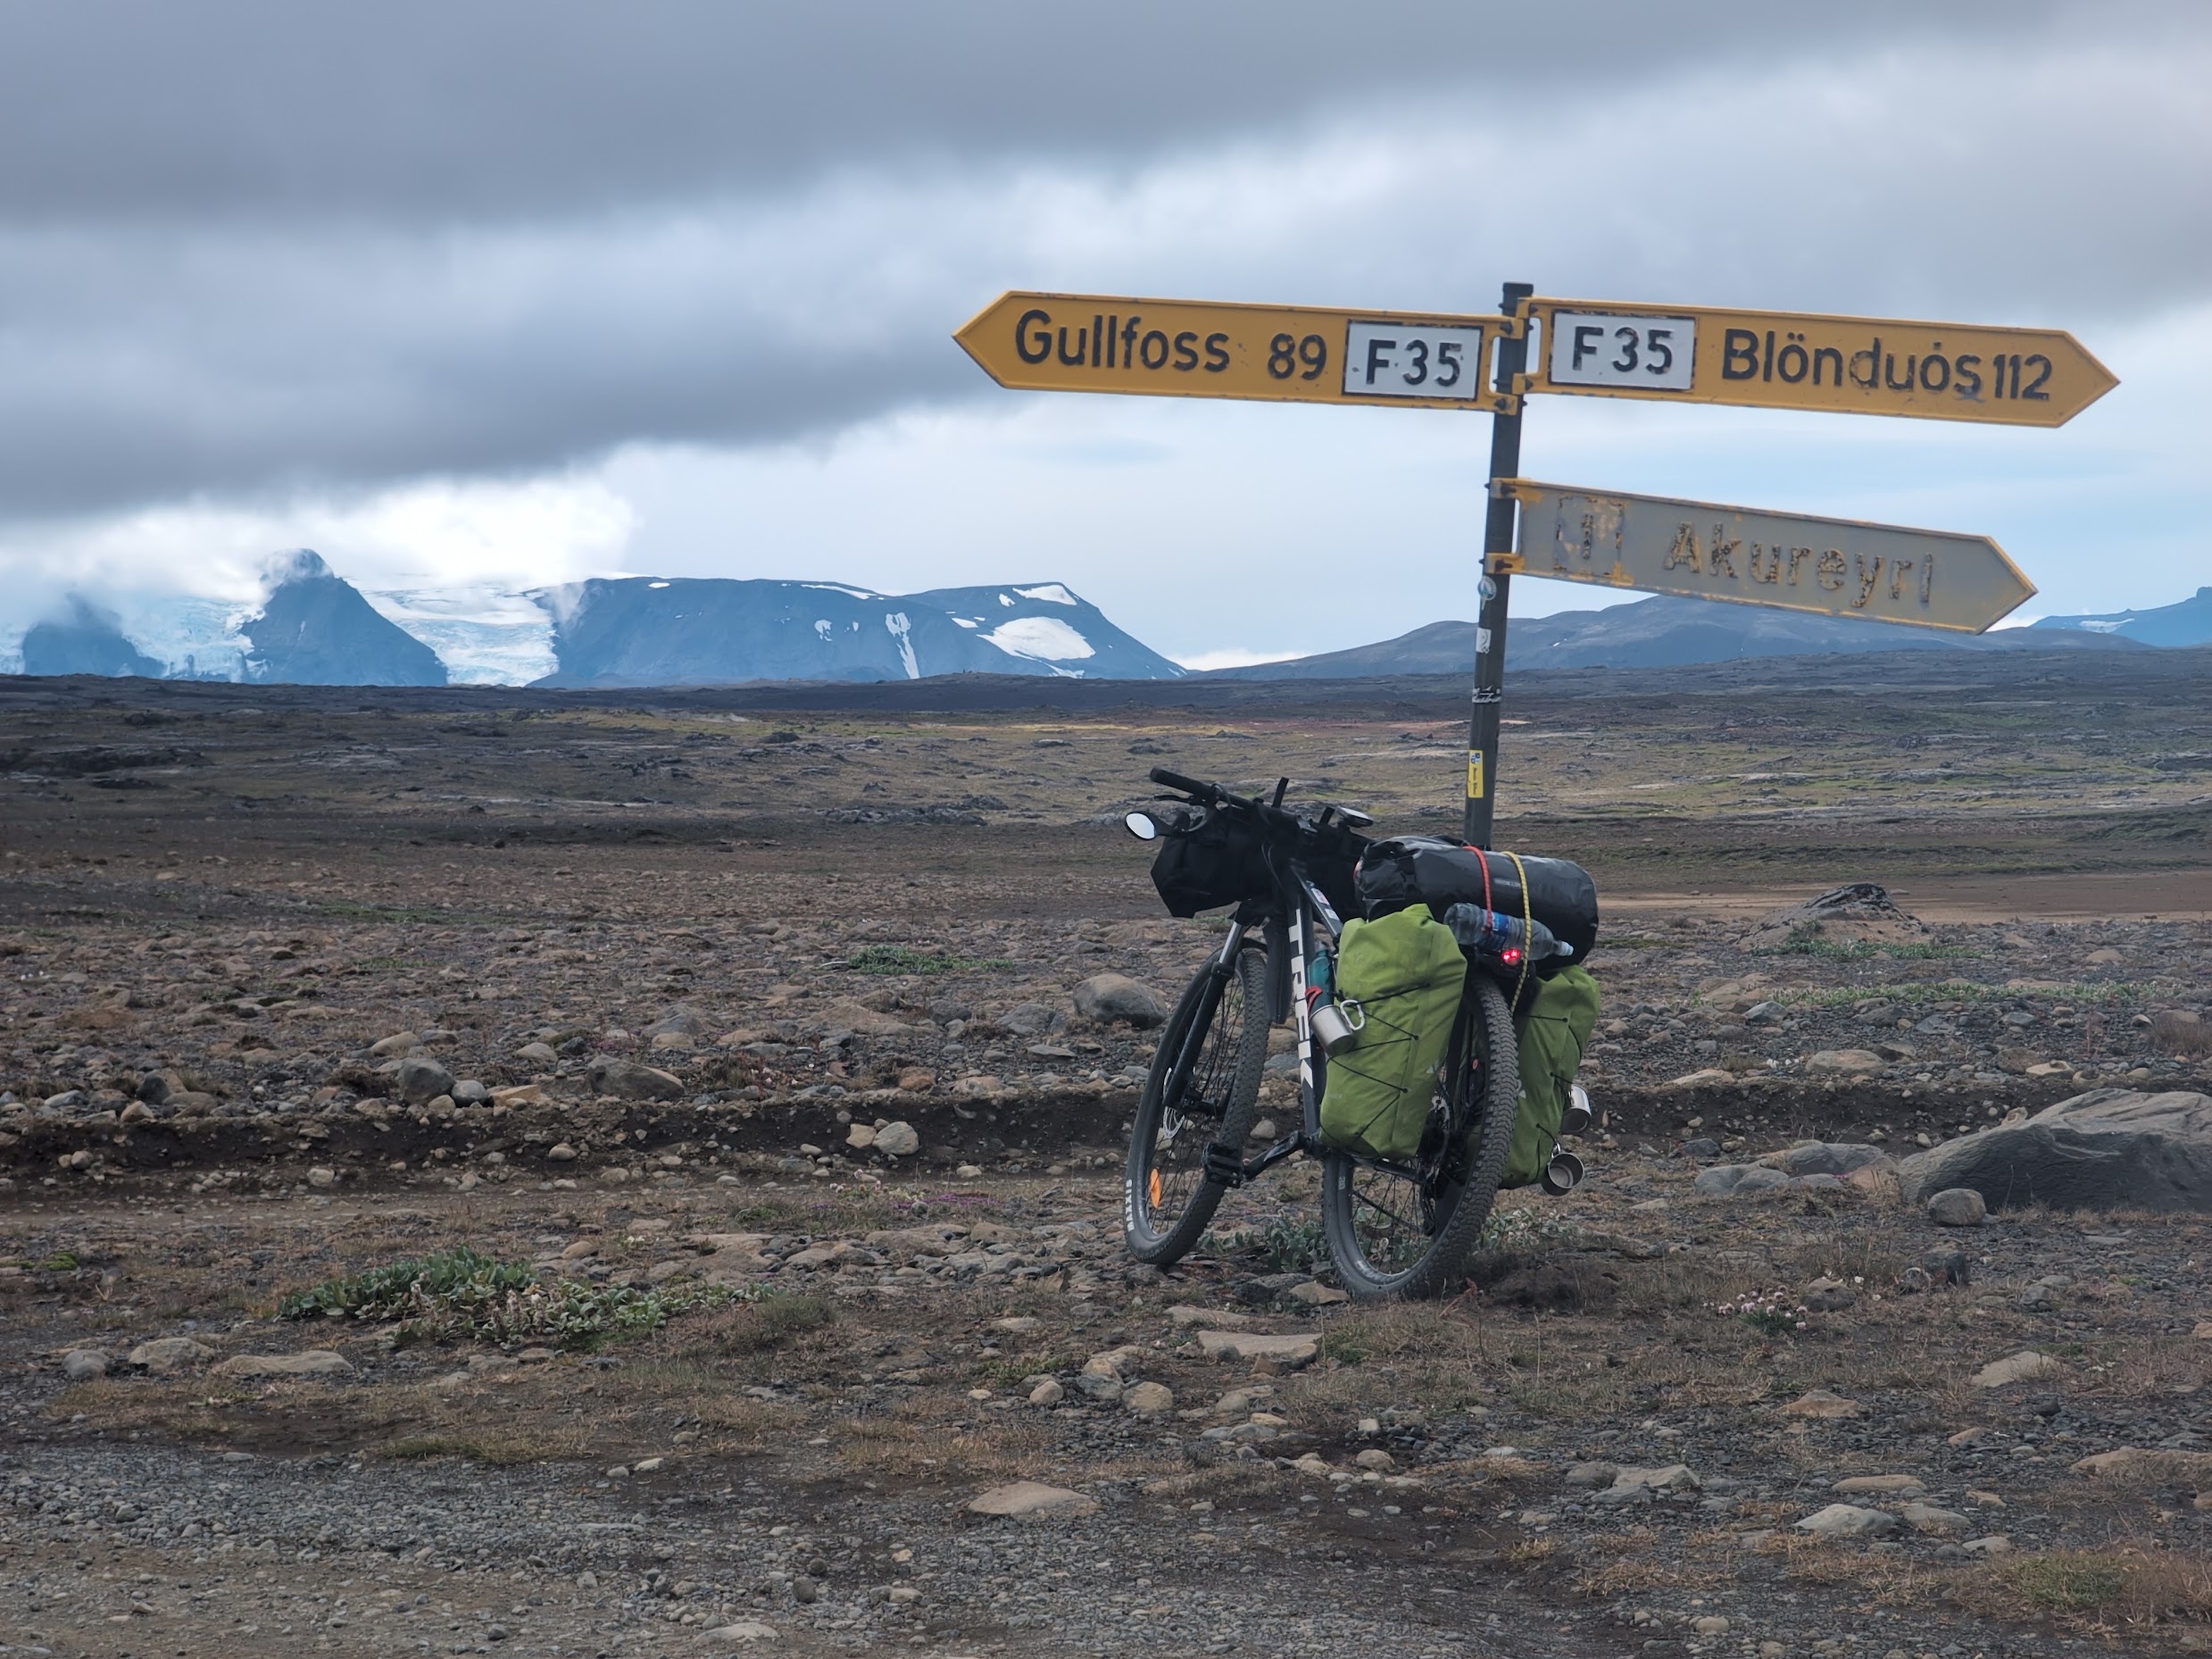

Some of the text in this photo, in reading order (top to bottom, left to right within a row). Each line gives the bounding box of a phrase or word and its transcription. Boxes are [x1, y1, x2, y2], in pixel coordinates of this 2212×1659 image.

[1015, 309, 1463, 388] Gullfoss 89 F35
[1571, 325, 2053, 401] F35 Blönduós 112
[1663, 521, 1934, 608] Akureyri
[1288, 908, 1315, 1089] TREK
[1125, 1179, 1135, 1232] MAXXIS
